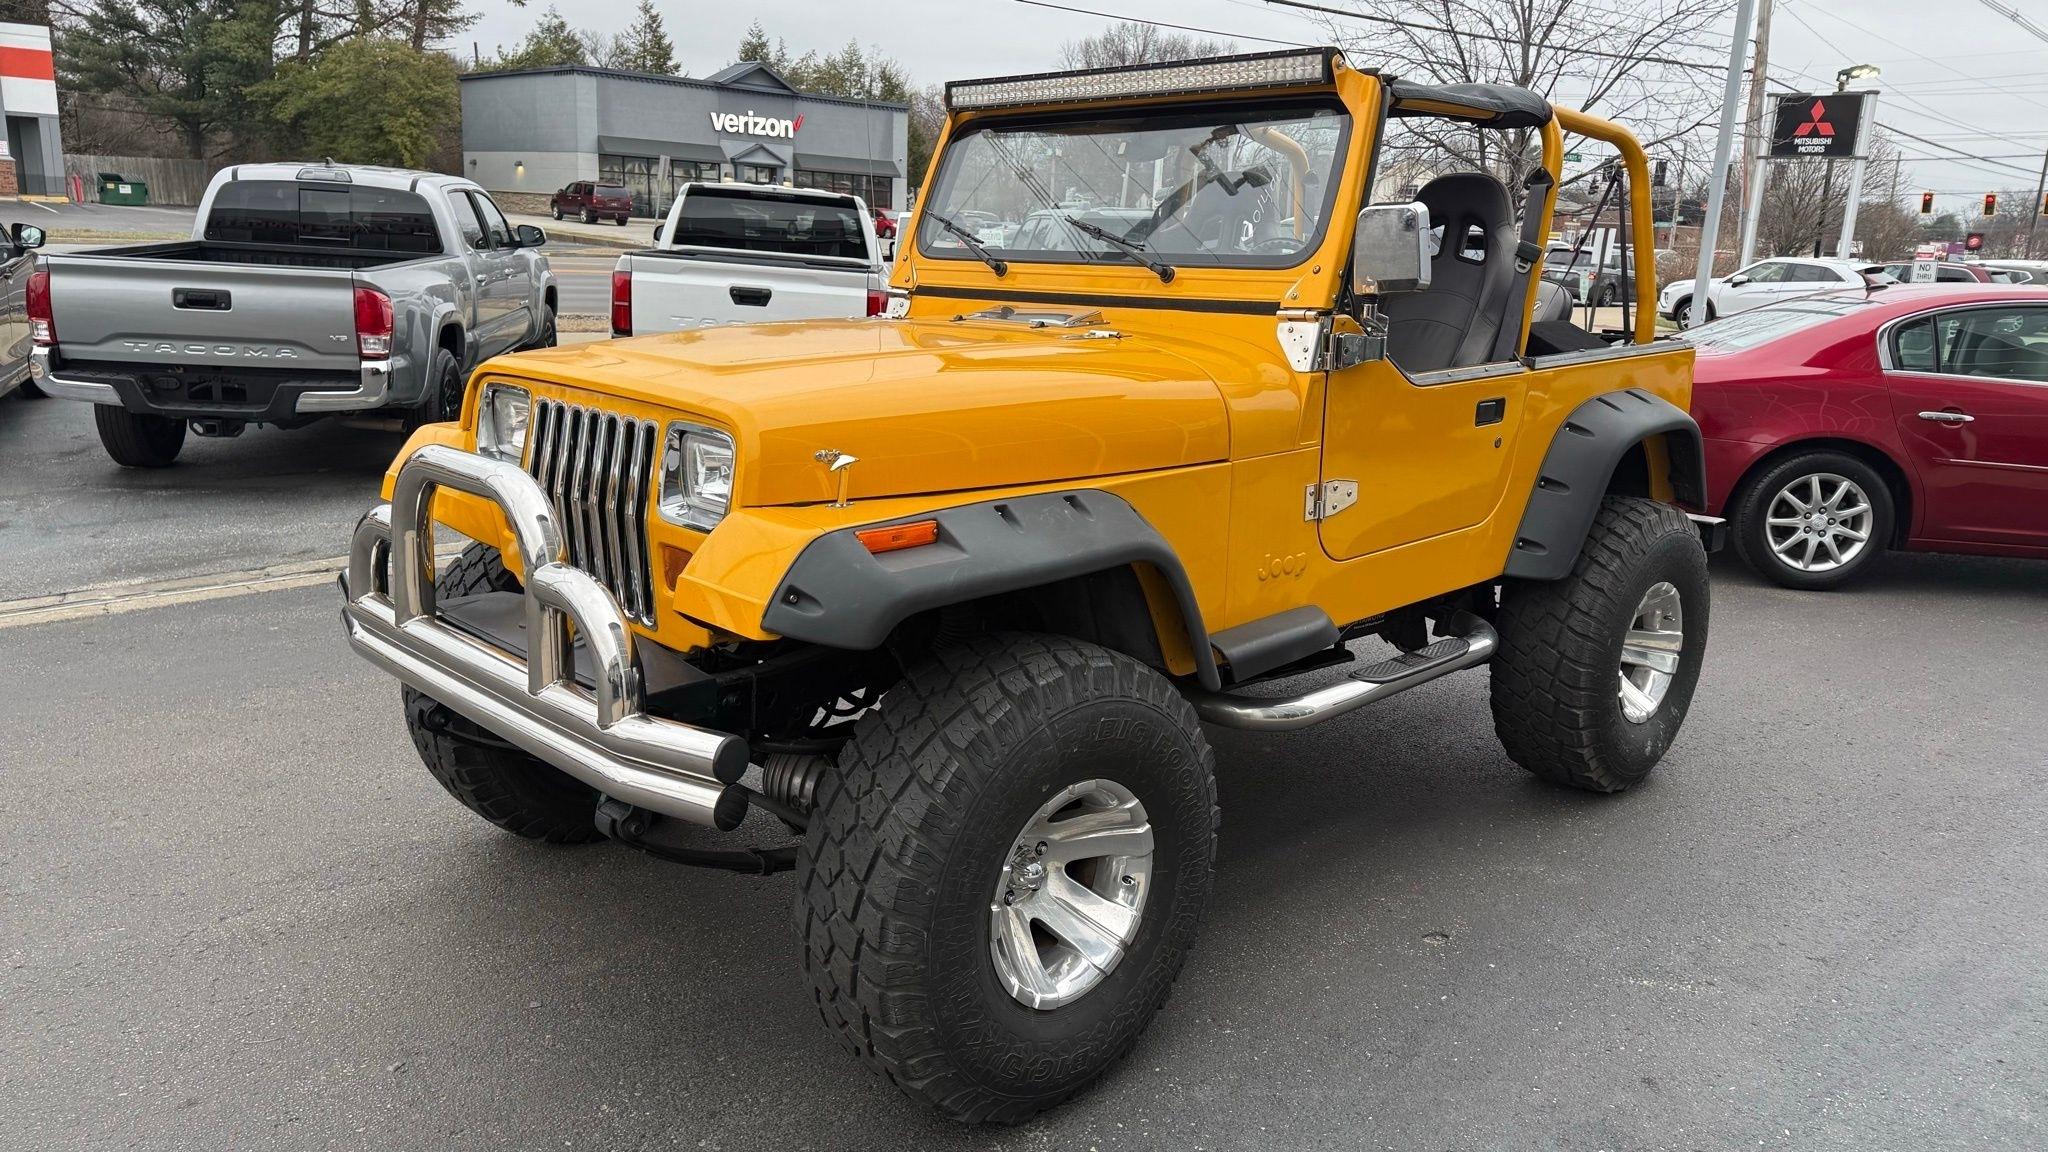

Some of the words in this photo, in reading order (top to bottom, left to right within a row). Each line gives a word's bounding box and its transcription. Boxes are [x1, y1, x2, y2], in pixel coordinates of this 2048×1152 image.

[710, 110, 794, 139] verizon
[1794, 137, 1832, 145] MITSUBISHI
[1919, 263, 1931, 272] NO
[124, 341, 298, 358] TACOMA
